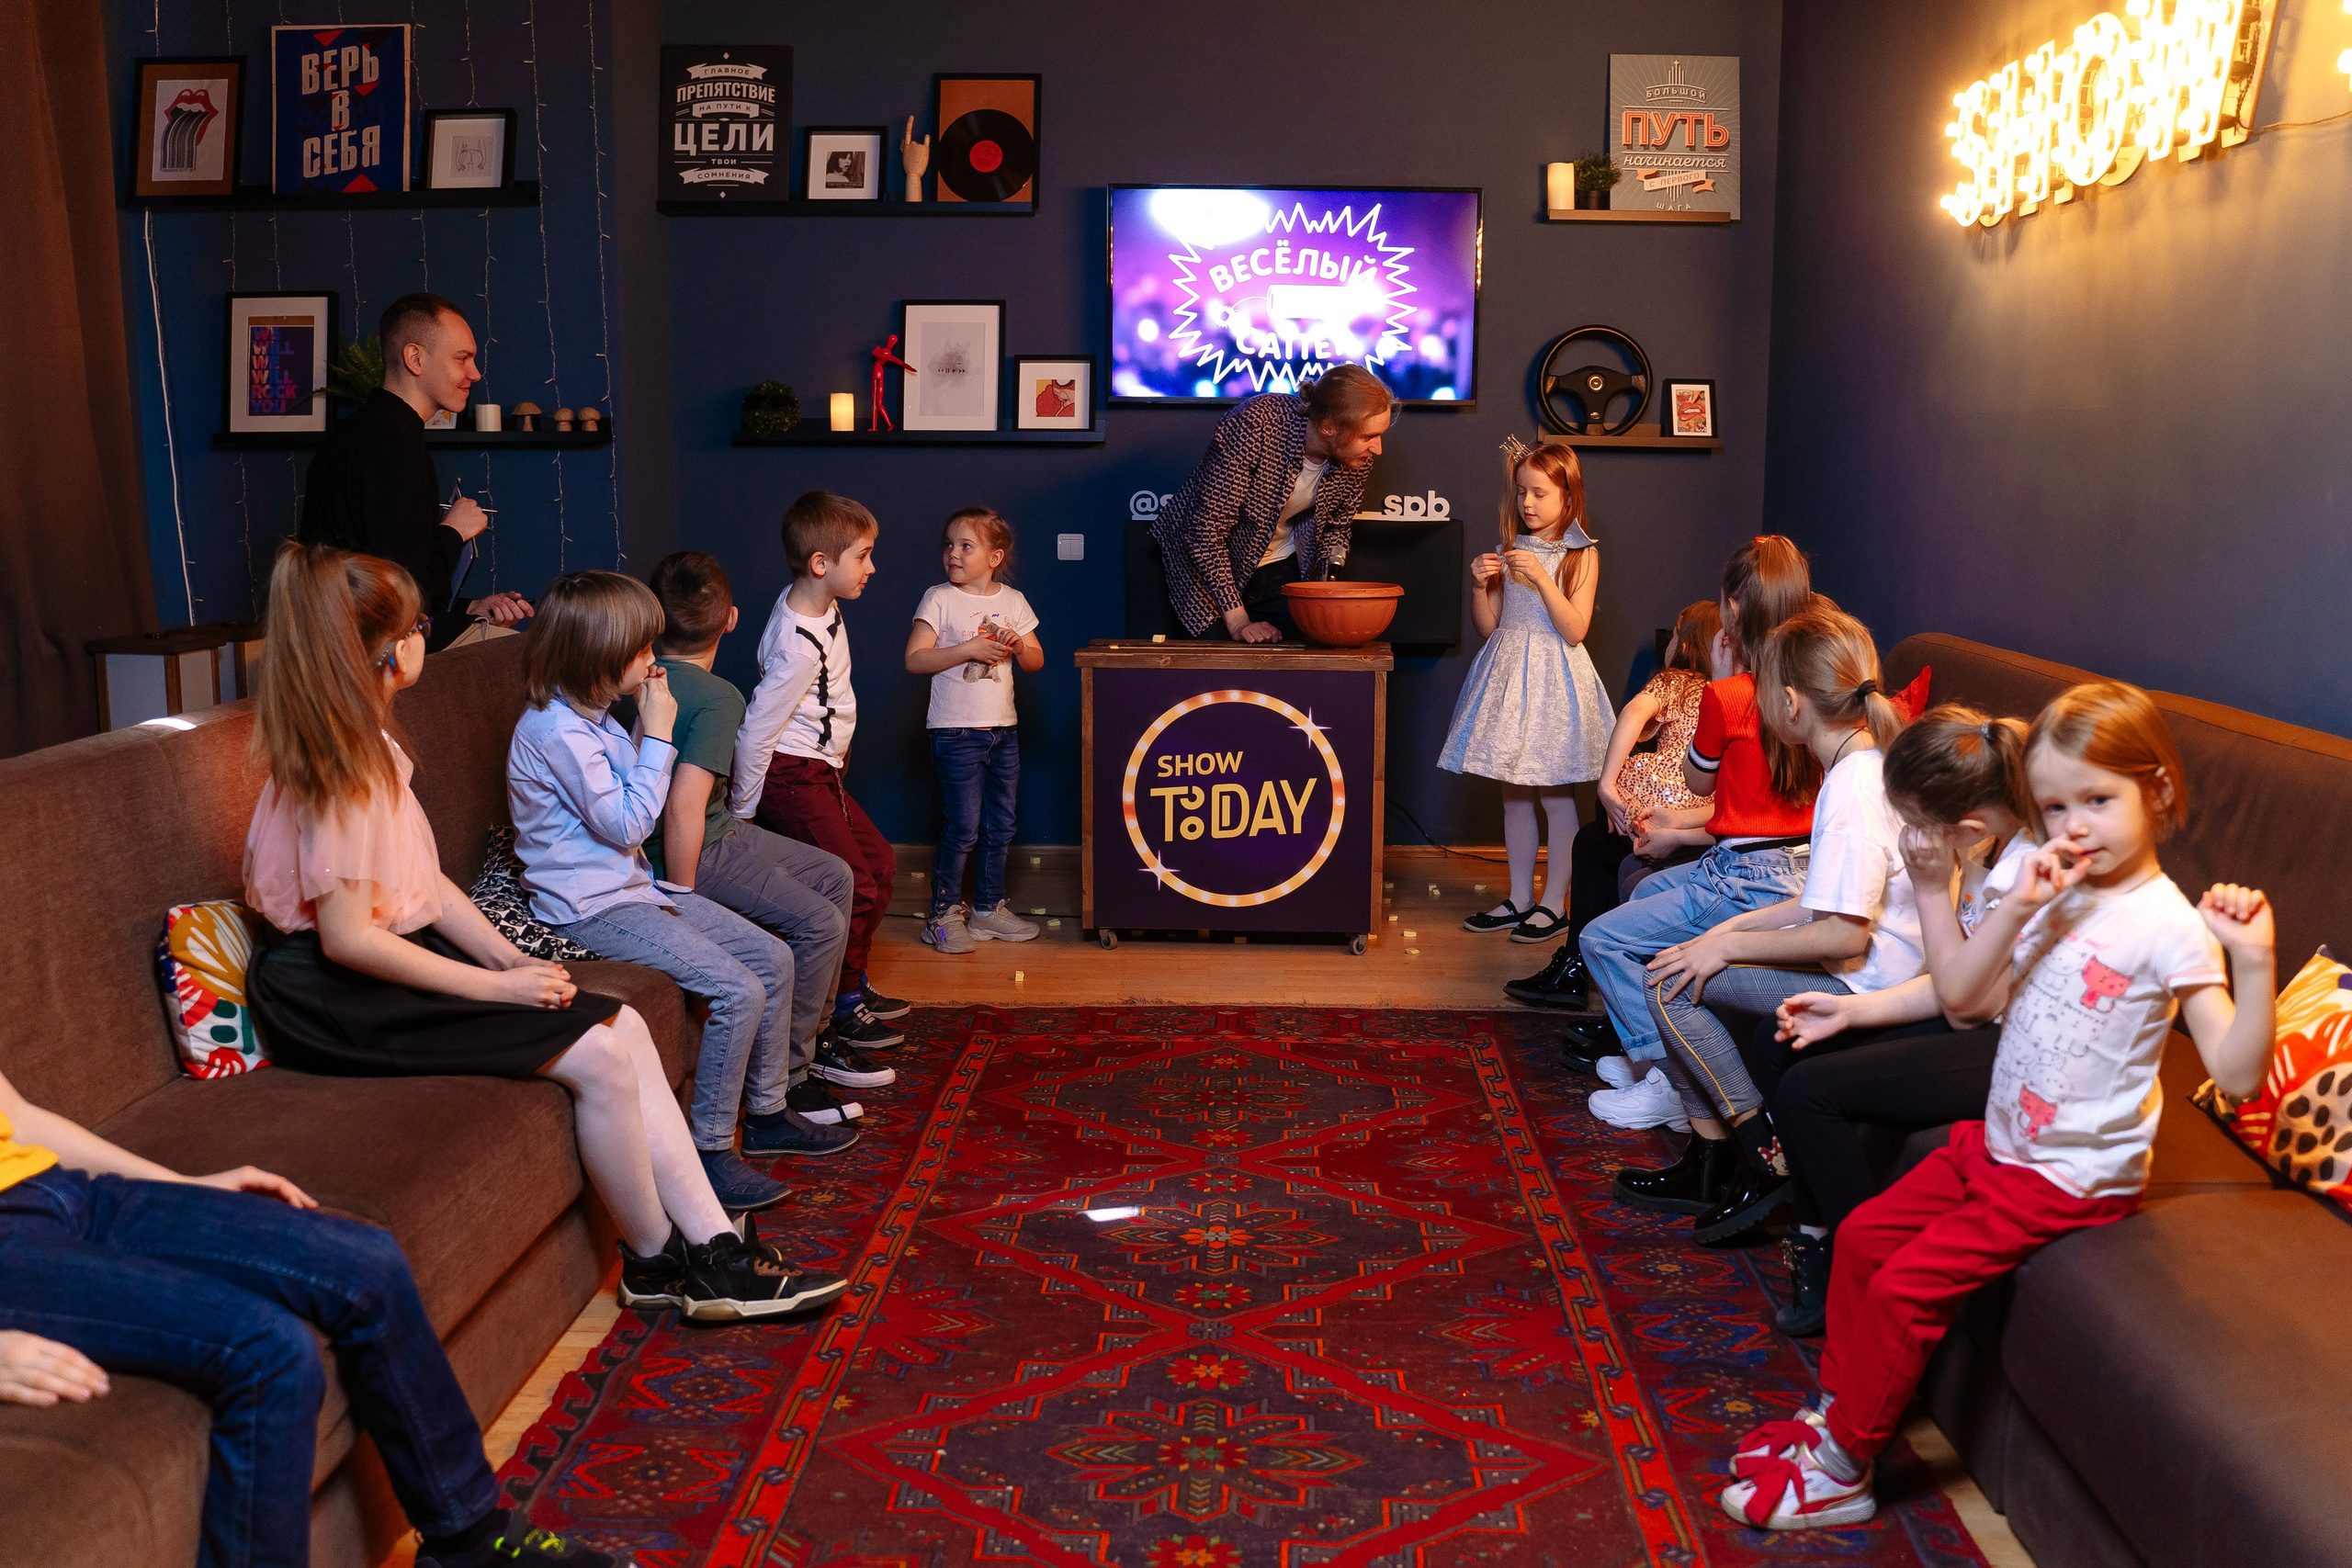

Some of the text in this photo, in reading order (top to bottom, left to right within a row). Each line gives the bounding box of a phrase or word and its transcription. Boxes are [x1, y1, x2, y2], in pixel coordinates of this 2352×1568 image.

[301, 43, 379, 96] ВЕРЬ
[704, 67, 750, 75] ГЛАВНОЕ
[676, 82, 775, 104] ПРЕПЯТСТВИЕ
[1645, 87, 1705, 99] БОЛЬШОЙ
[332, 89, 350, 132] В
[1940, 0, 2262, 227] SHOW
[1622, 110, 1730, 149] ПУТЬ
[674, 123, 775, 156] ЦЕЛИ
[302, 125, 381, 179] СЕБЯ
[1623, 154, 1727, 168] начинается
[696, 171, 751, 180] СОМНЕНИЯ
[1660, 172, 1701, 186] ПЕРВОГО
[1656, 201, 1692, 211] ШАГА
[1208, 239, 1378, 293] ВЕСЁЛЫЙ
[252, 327, 280, 341] WE
[253, 341, 294, 355] WILL
[251, 355, 280, 369] WE
[251, 369, 294, 384] WILL
[251, 384, 298, 399] ROCK
[251, 399, 287, 414] YOU
[1158, 750, 1244, 778] SHOW
